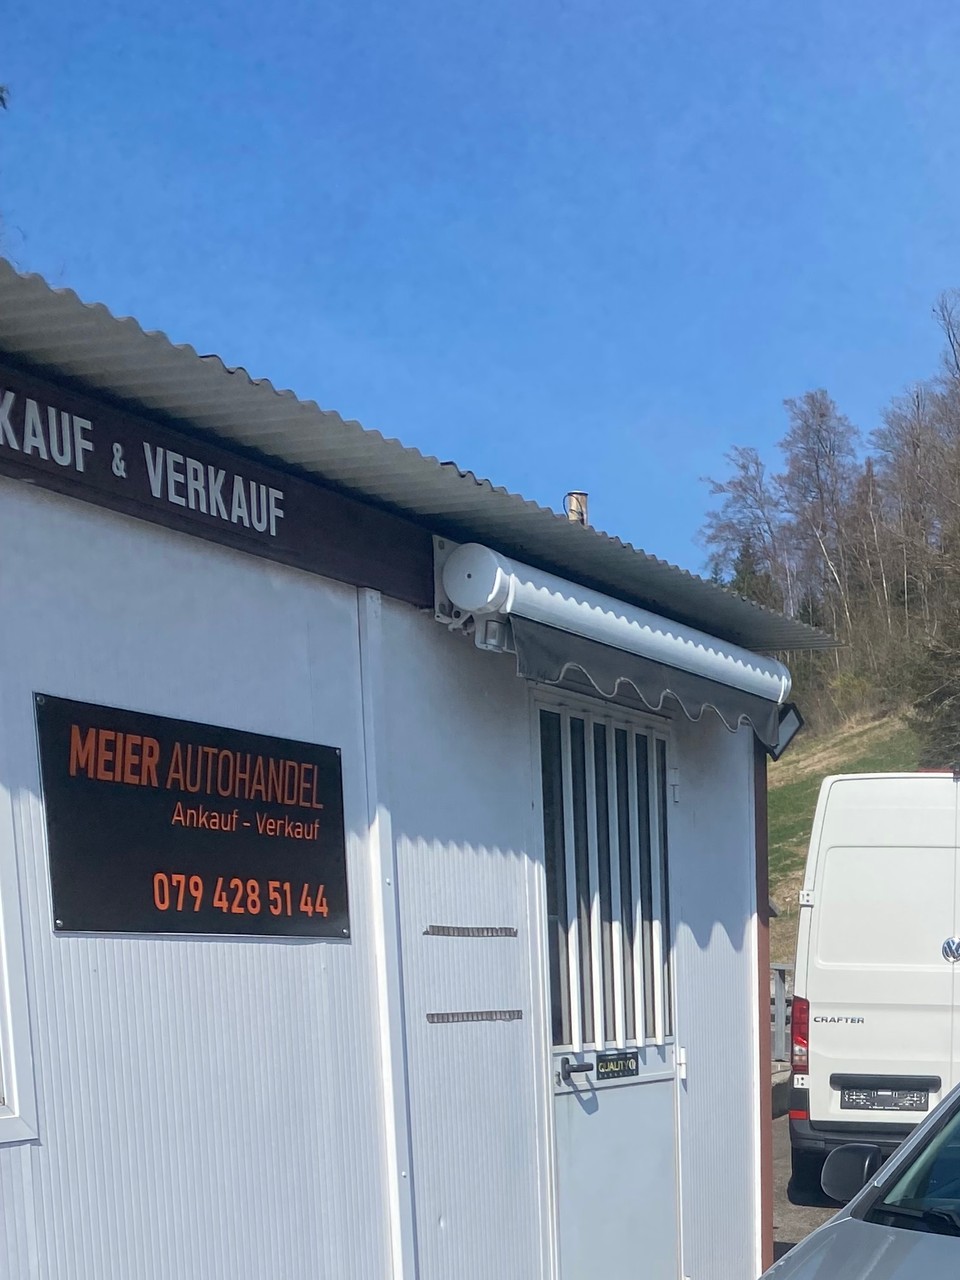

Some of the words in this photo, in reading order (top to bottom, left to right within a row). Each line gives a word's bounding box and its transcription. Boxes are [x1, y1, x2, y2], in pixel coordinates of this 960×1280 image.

[111, 442, 127, 479] &
[143, 441, 285, 537] VERKAUF
[69, 724, 160, 788] MEIER
[165, 741, 324, 809] AUTOHANDEL
[171, 801, 239, 832] Ankauf
[255, 811, 320, 841] Verkauf
[153, 872, 203, 912] 079
[213, 877, 261, 916] 428
[268, 880, 293, 917] 51
[300, 883, 329, 918] 44
[813, 1016, 865, 1024] CRAFTER
